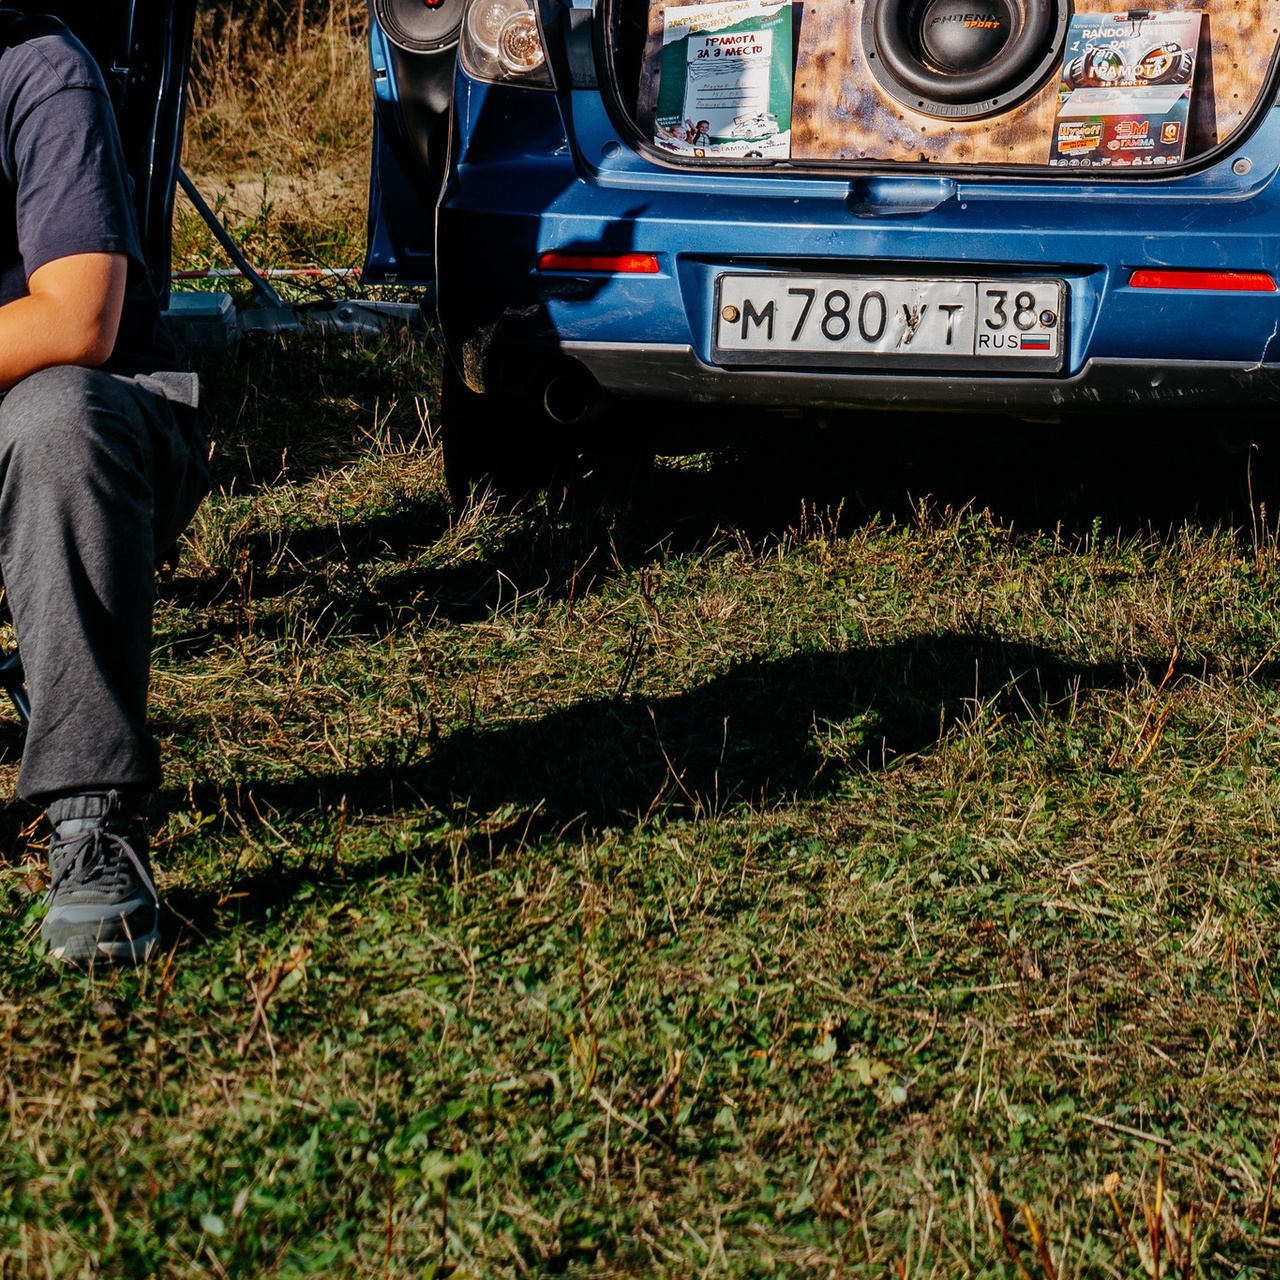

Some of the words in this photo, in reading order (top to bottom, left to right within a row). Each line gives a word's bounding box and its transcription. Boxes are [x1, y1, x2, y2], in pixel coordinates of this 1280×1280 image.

[931, 14, 1002, 27] PHOENIX
[963, 21, 1000, 29] SPORT
[705, 34, 755, 47] ГРАМОТА
[697, 49, 709, 58] ЗА
[725, 46, 762, 57] МЕСТО
[1089, 64, 1162, 78] ГРАМОТА
[1121, 138, 1155, 147] ГАММА
[985, 290, 1037, 331] 38
[979, 333, 1018, 349] RUS
